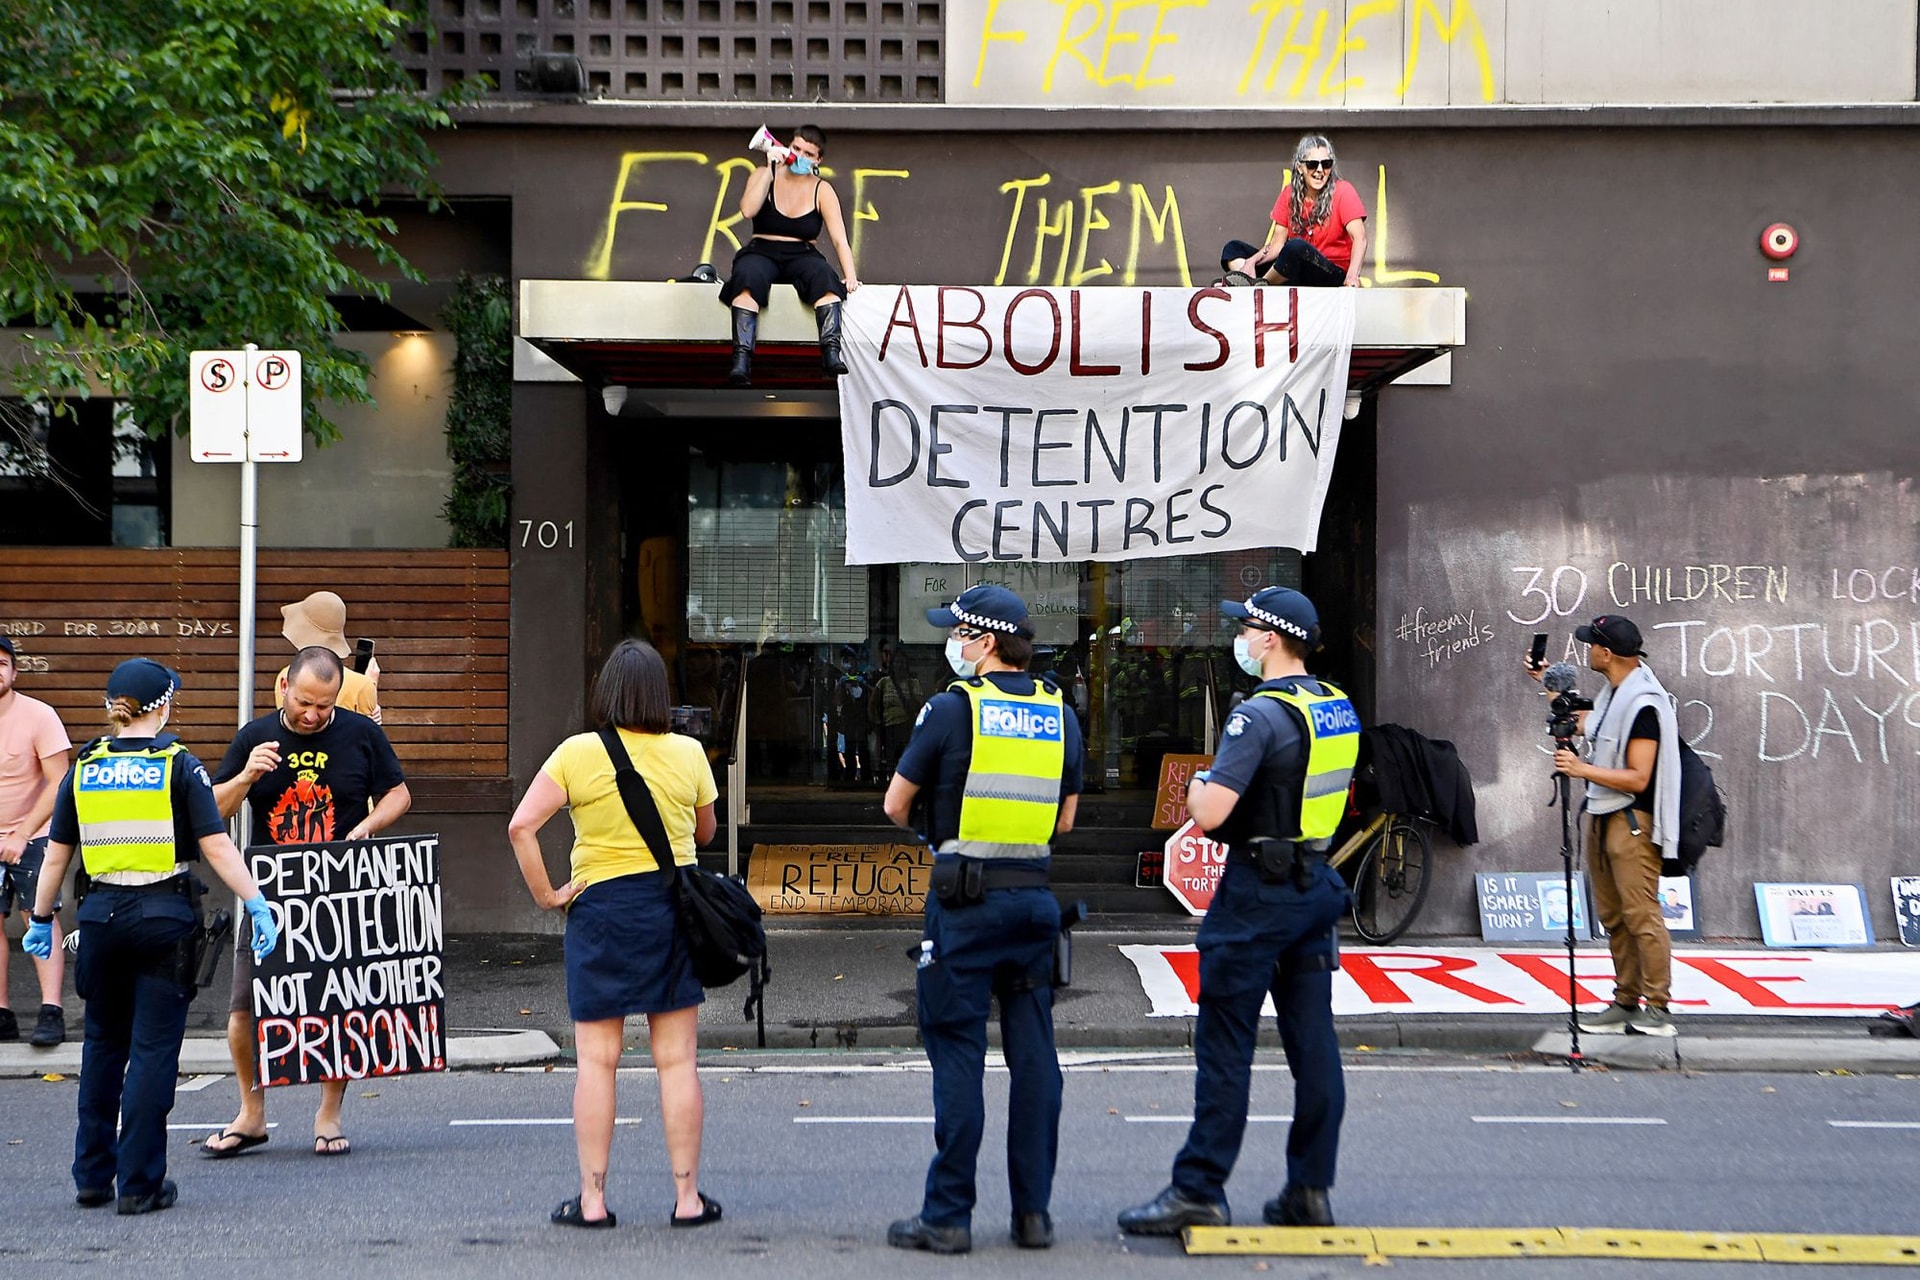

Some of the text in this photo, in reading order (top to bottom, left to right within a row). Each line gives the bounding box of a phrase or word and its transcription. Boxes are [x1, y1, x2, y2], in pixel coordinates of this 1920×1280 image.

[974, 0, 1493, 102] FREE THEM
[588, 152, 910, 280] FRE
[995, 173, 1193, 286] THEM
[878, 284, 1299, 377] ABOLISH
[869, 388, 1327, 488] DETENTION
[519, 520, 573, 548] 701
[951, 484, 1233, 562] CENTRES
[924, 577, 947, 592] FOR
[1507, 565, 1587, 625] 30
[1607, 561, 1788, 607] CHILDREN
[64, 620, 99, 637] FOR
[177, 618, 234, 637] DAYS
[1396, 606, 1475, 643] #freemy
[1420, 624, 1495, 668] friends
[982, 704, 1059, 735] Police
[1312, 704, 1359, 733] Police
[82, 761, 162, 785] Police
[287, 751, 329, 769] 3CR
[251, 840, 439, 896] PERMANENT
[808, 852, 879, 864] FREE
[781, 862, 928, 897] REFUGE
[1483, 877, 1518, 894] IS IT
[770, 894, 806, 911] END
[252, 955, 445, 1017] NOT ANOTHER
[258, 1004, 444, 1087] PRISON!
